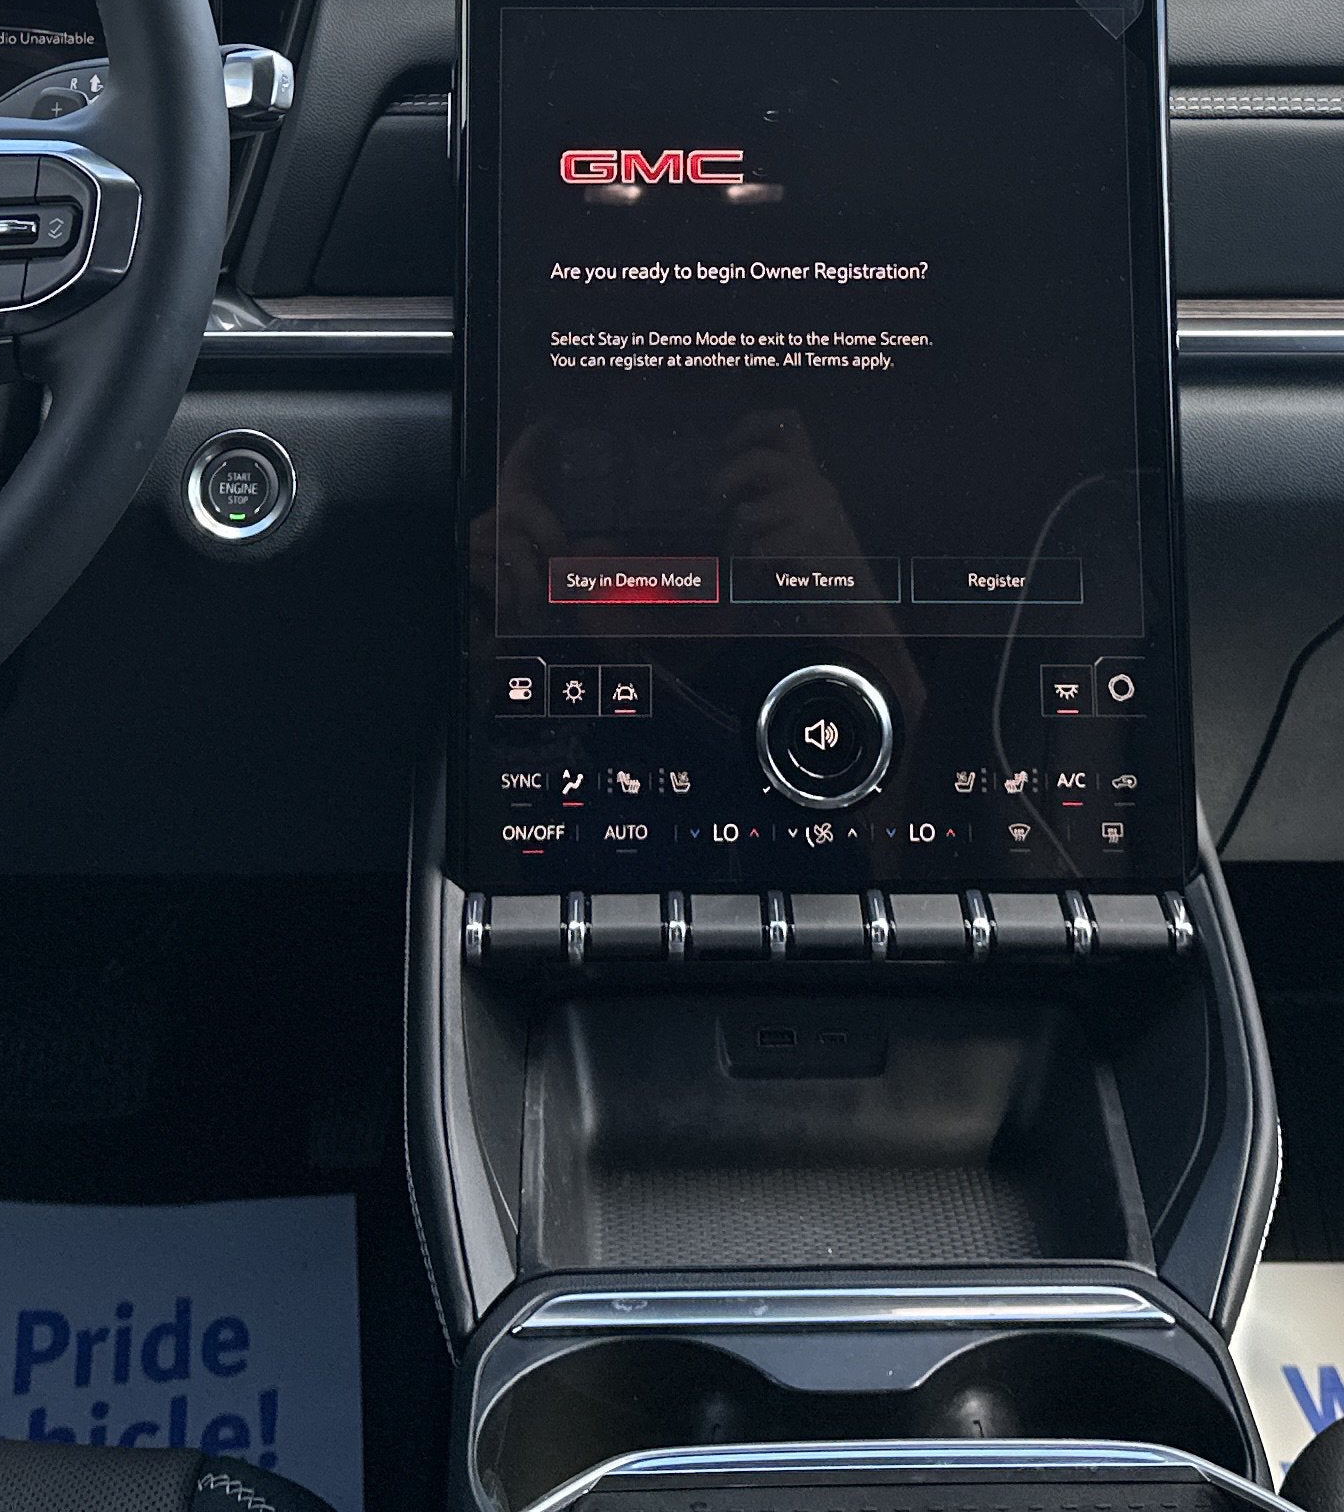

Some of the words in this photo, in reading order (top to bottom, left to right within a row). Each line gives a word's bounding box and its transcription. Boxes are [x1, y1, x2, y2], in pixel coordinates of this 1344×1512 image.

[20, 30, 95, 45] Unavailable
[69, 77, 78, 90] R
[560, 149, 744, 184] GMC
[549, 262, 582, 280] Are
[584, 266, 617, 285] you
[621, 261, 670, 284] ready
[673, 263, 693, 280] to
[696, 261, 746, 284] begin
[749, 261, 810, 280] Owner
[814, 261, 929, 285] Registration?
[550, 331, 595, 347] Select
[598, 331, 629, 350] Stay
[631, 331, 645, 346] in
[648, 331, 692, 346] Demo
[695, 330, 737, 346] Mode
[740, 332, 755, 346] to
[758, 331, 785, 346] exit
[787, 332, 803, 346] to
[805, 330, 830, 346] the
[833, 331, 877, 346] Home
[880, 331, 934, 346] Screen.
[549, 352, 576, 367] You
[579, 355, 606, 368] can
[609, 352, 664, 371] register
[666, 353, 682, 367] at
[684, 351, 741, 367] another
[743, 353, 780, 367] time.
[782, 351, 802, 367] All
[804, 351, 849, 367] Terms
[851, 354, 895, 371] apply.
[227, 472, 251, 482] START
[219, 482, 258, 495] ENGINE
[227, 495, 249, 505] STOP
[566, 572, 597, 591] Stay
[599, 574, 612, 587] in
[615, 572, 658, 588] Demo
[661, 572, 702, 588] Mode
[775, 572, 810, 587] View
[811, 572, 855, 587] Terms
[968, 572, 1027, 592] Register
[501, 772, 543, 790] SYNC
[1056, 772, 1087, 789] A/C
[502, 822, 566, 841] ON/OFF
[603, 823, 648, 841] AUTO
[713, 823, 740, 843] LO
[909, 822, 936, 843] LO
[12, 1296, 252, 1396] Pride
